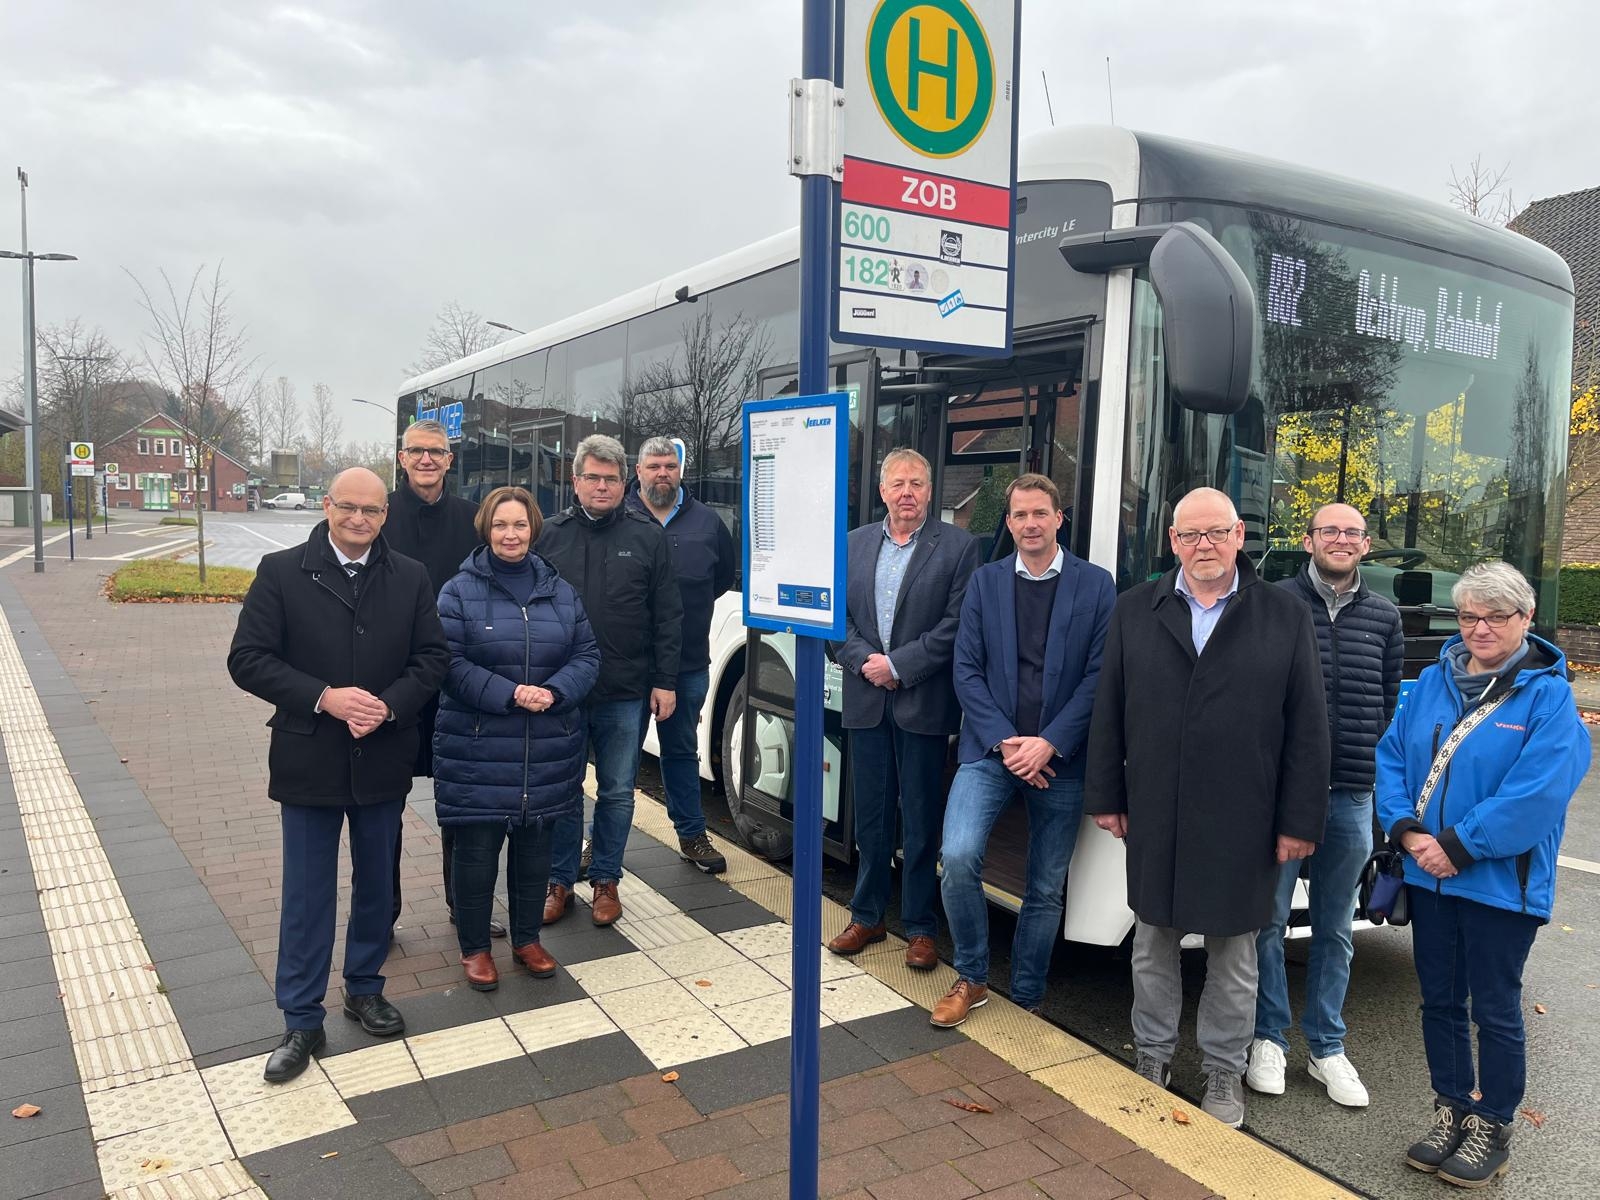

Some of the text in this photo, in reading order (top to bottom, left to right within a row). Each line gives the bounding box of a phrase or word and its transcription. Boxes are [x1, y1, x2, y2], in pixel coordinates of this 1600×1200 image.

[908, 16, 958, 121] H
[901, 176, 957, 211] ZOB
[844, 211, 891, 243] 600
[1062, 219, 1077, 233] LE
[845, 255, 889, 287] 182
[1355, 269, 1430, 354] Ochtrup,
[1434, 286, 1503, 360] Bahnhof
